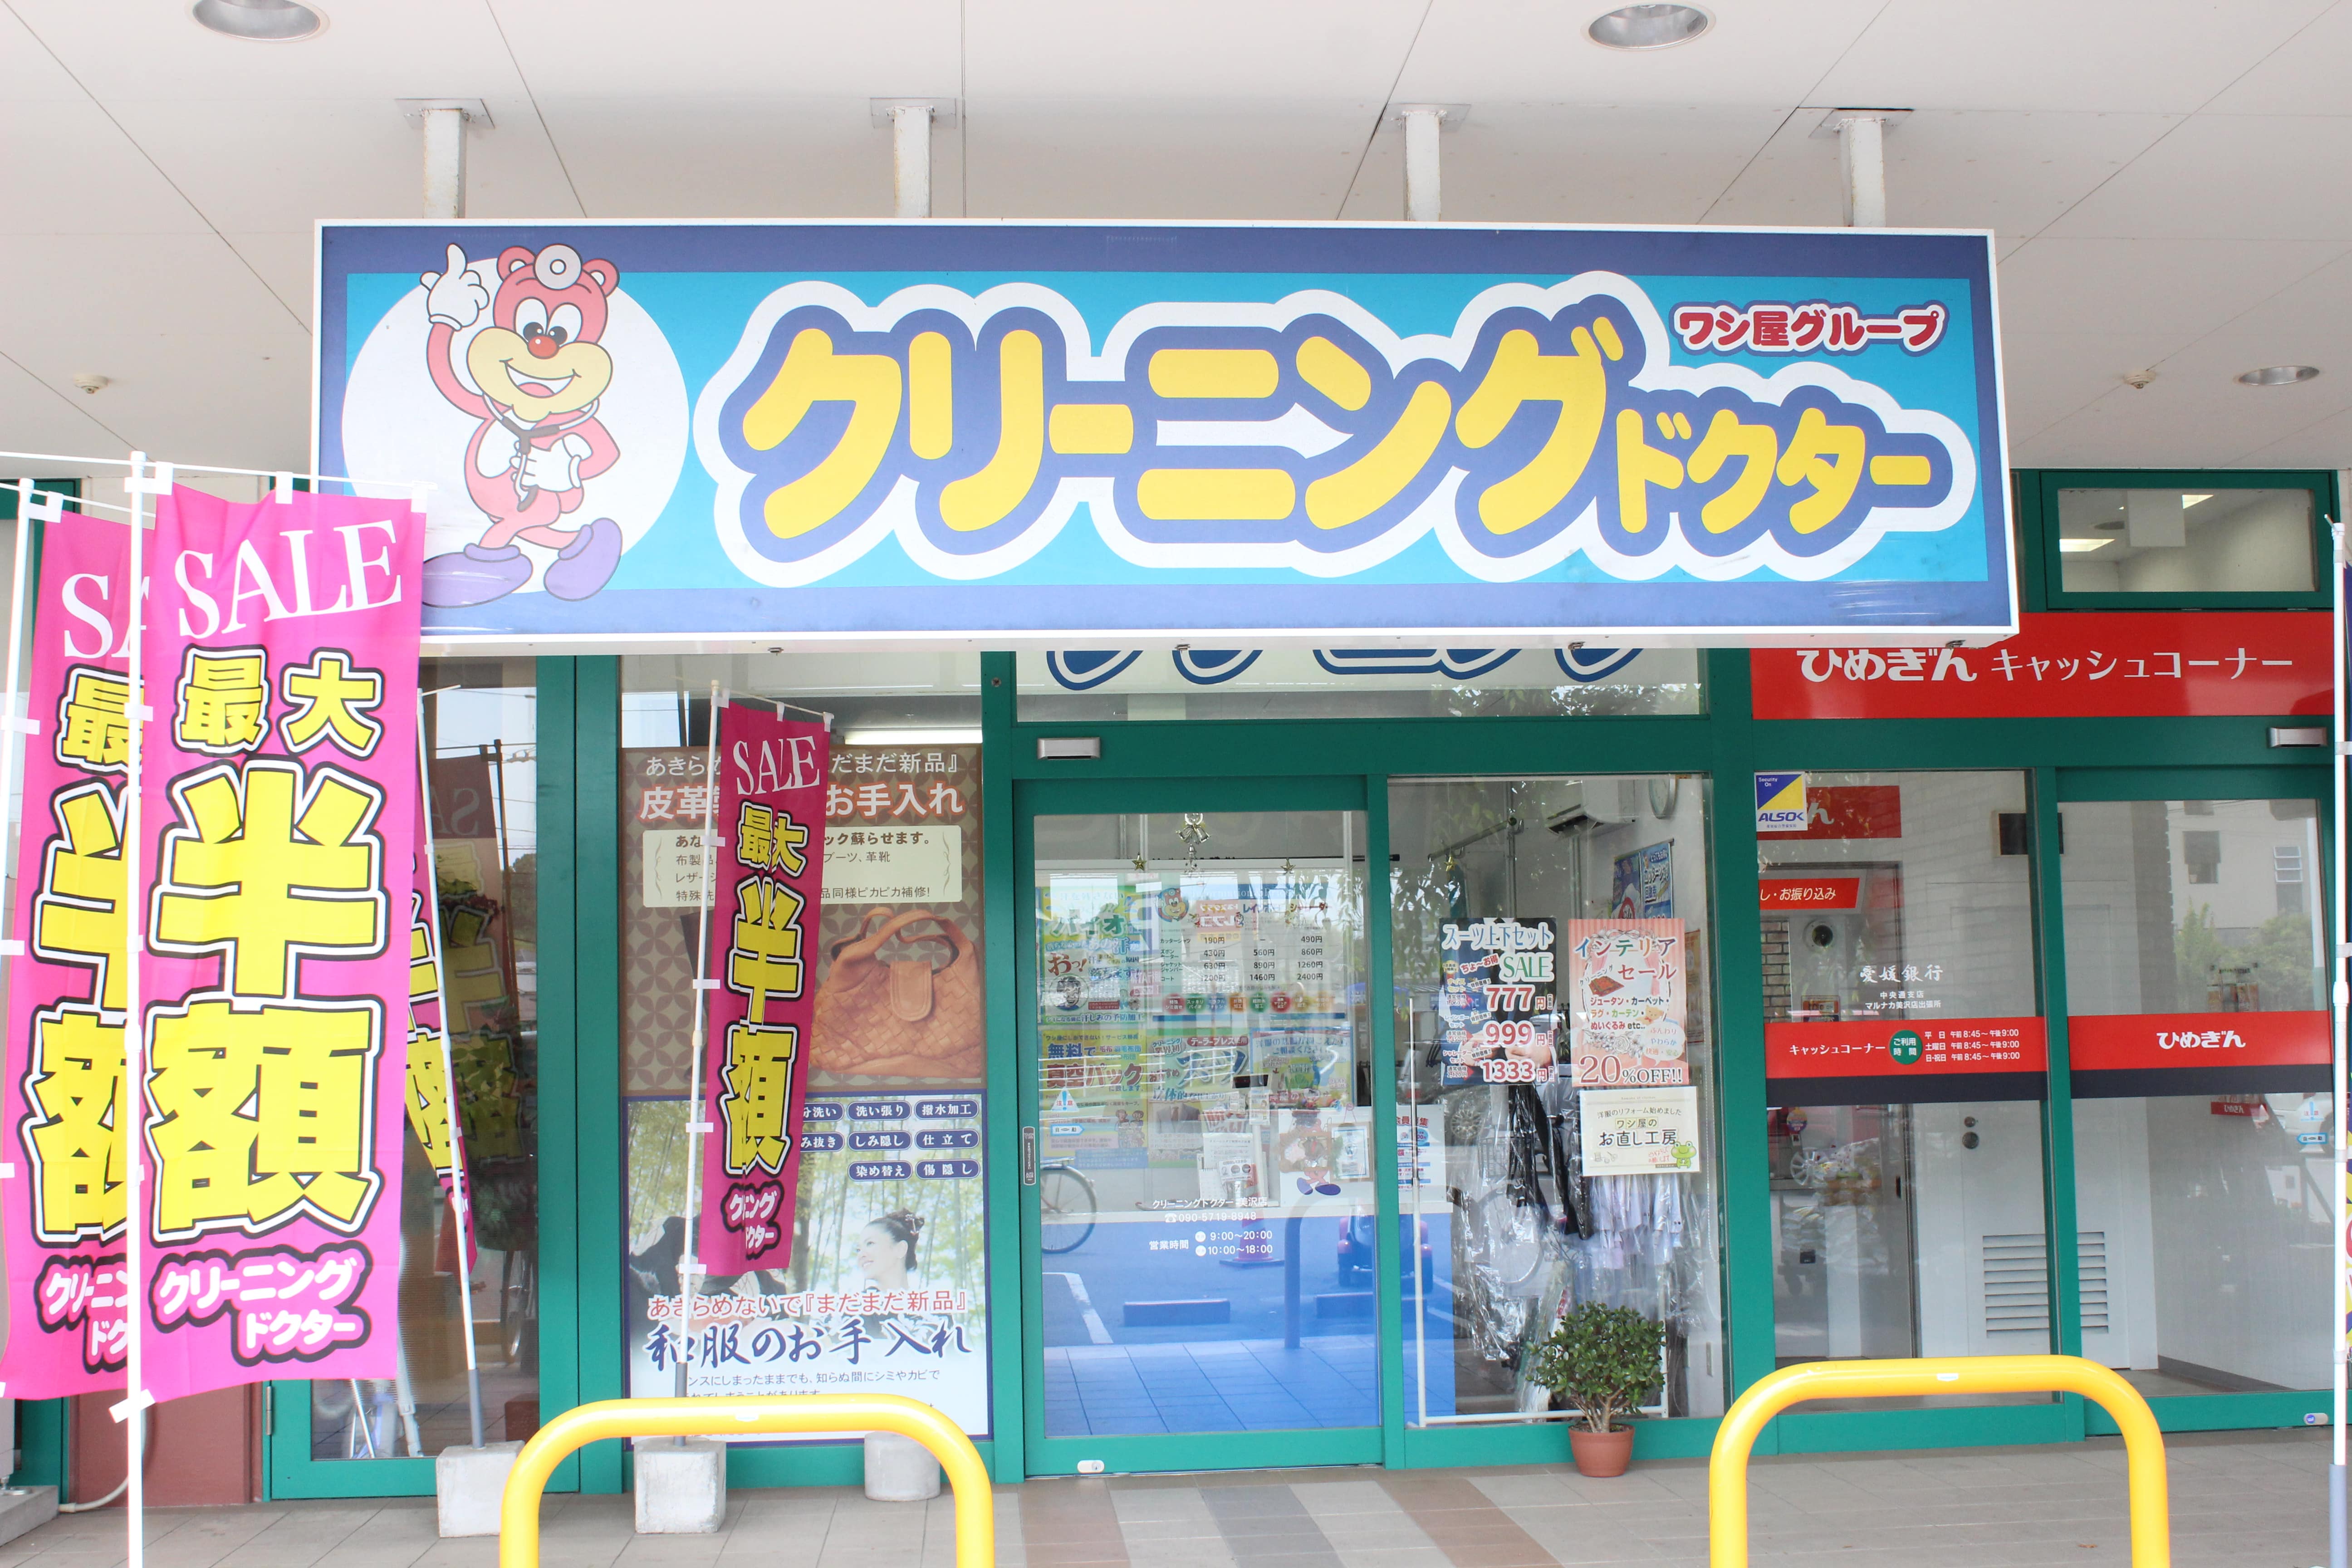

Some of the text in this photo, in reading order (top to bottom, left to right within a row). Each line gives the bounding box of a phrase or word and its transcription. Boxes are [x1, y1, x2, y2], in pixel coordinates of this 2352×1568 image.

[1679, 310, 1939, 347] ワシ屋グループ
[742, 314, 1933, 539] クリーニング ドクター
[174, 519, 402, 639] SALE
[1797, 647, 2294, 682] ひめぎん キャッシュコーナー
[177, 647, 383, 757] 最大
[733, 735, 820, 796] SALE
[640, 783, 963, 820] 皮革 お手入れ
[1758, 812, 1804, 822] ALSOK
[740, 803, 808, 876] 最大
[1445, 925, 1551, 947] スーツ上下セット
[1575, 938, 1676, 957] インテリア
[1296, 973, 1323, 981] 2400円
[1503, 956, 1551, 978] SALE
[1617, 964, 1677, 980] セール
[1860, 964, 1944, 984] 愛媛銀行
[150, 759, 388, 1245] 半額
[1486, 988, 1532, 1009] 777
[1536, 997, 1545, 1009] 円
[1865, 1000, 1941, 1009] マルナカ美沢店出張所
[1880, 990, 1925, 999] 中央通支店
[1485, 1023, 1532, 1045] 999
[1537, 1034, 1546, 1046] 円
[1590, 1021, 1626, 1030] ぬいぐるみ
[1789, 1037, 1917, 1057] キャッシュコーナー ご利用
[1925, 1042, 1946, 1051] 土曜日
[2156, 1030, 2246, 1050] ひめぎん
[1048, 1043, 1097, 1060] 無料で
[1482, 1061, 1533, 1080] 1333
[1537, 1069, 1547, 1082] 円
[856, 1105, 904, 1117] 洗い張り
[921, 1103, 972, 1116] 撥水加工
[1597, 1107, 1682, 1119] 洋服のリフォーム始めました
[1617, 1118, 1657, 1128] ワシ屋の
[856, 1133, 904, 1147] しみ隠し
[1598, 1129, 1677, 1147] お直し工房
[856, 1164, 905, 1177] 染め替え
[1152, 1198, 1234, 1210] クリーニングドクター
[1178, 1211, 1257, 1222] 090-5719-8948
[1149, 1240, 1189, 1250] 営業時間
[159, 1257, 358, 1314] クリーニング
[245, 1309, 357, 1349] ドクター
